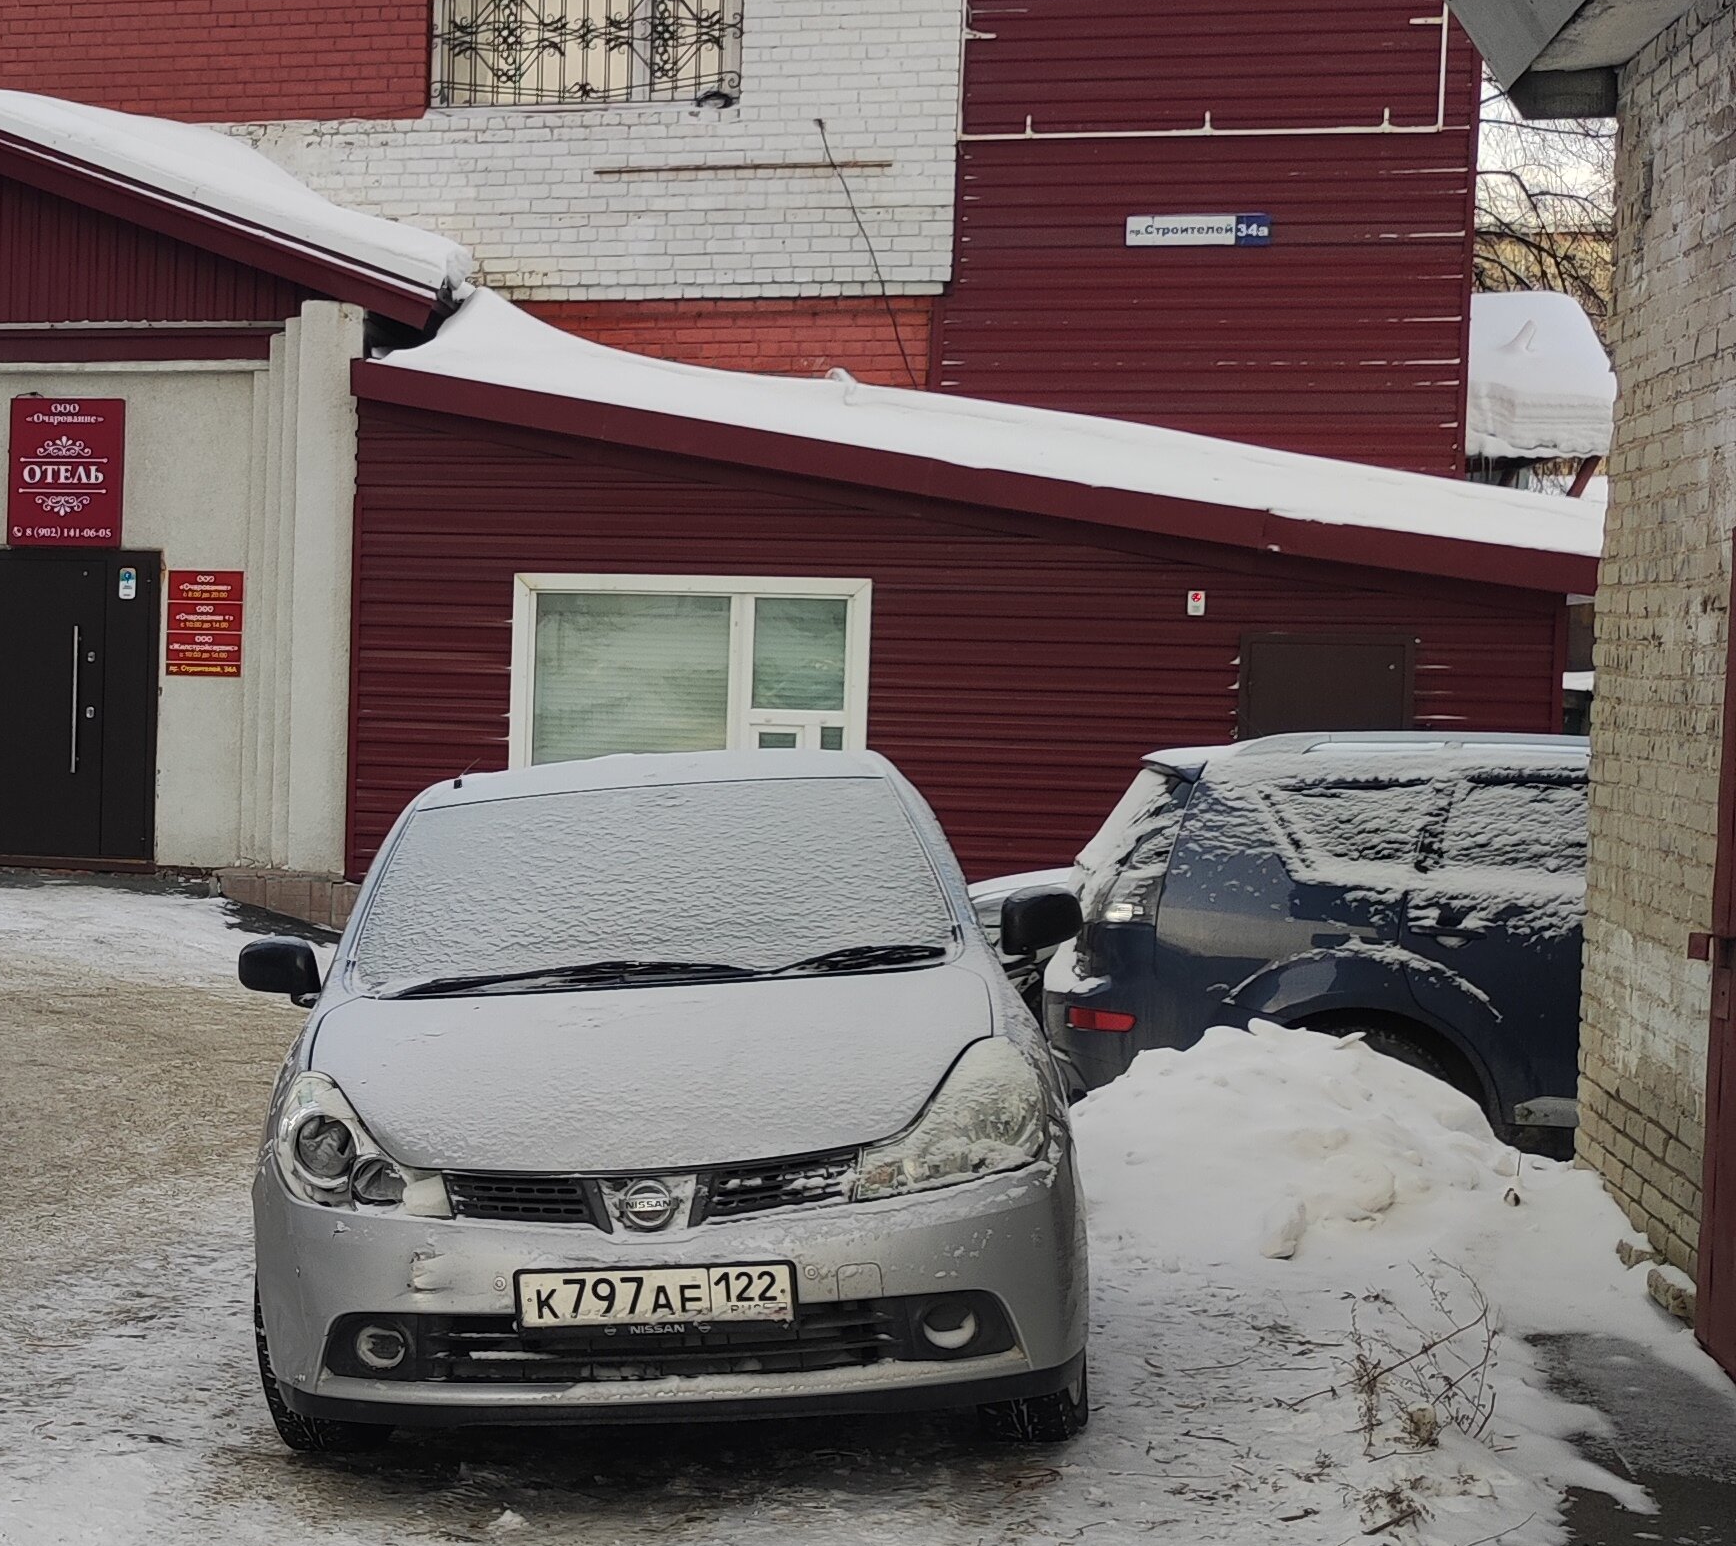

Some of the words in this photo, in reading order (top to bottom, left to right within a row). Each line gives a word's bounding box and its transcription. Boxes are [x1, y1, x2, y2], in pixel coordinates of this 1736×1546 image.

[1237, 223, 1269, 237] 34а
[51, 403, 79, 413] ООО
[26, 413, 104, 425] «Очарование»
[23, 464, 104, 483] ОТЕЛЬ
[26, 528, 32, 536] 8
[34, 526, 61, 538] (902)
[63, 528, 112, 538] 141-06-05
[625, 1199, 672, 1209] NISSAN
[714, 1271, 778, 1302] 122
[629, 1323, 685, 1334] NISSAN
